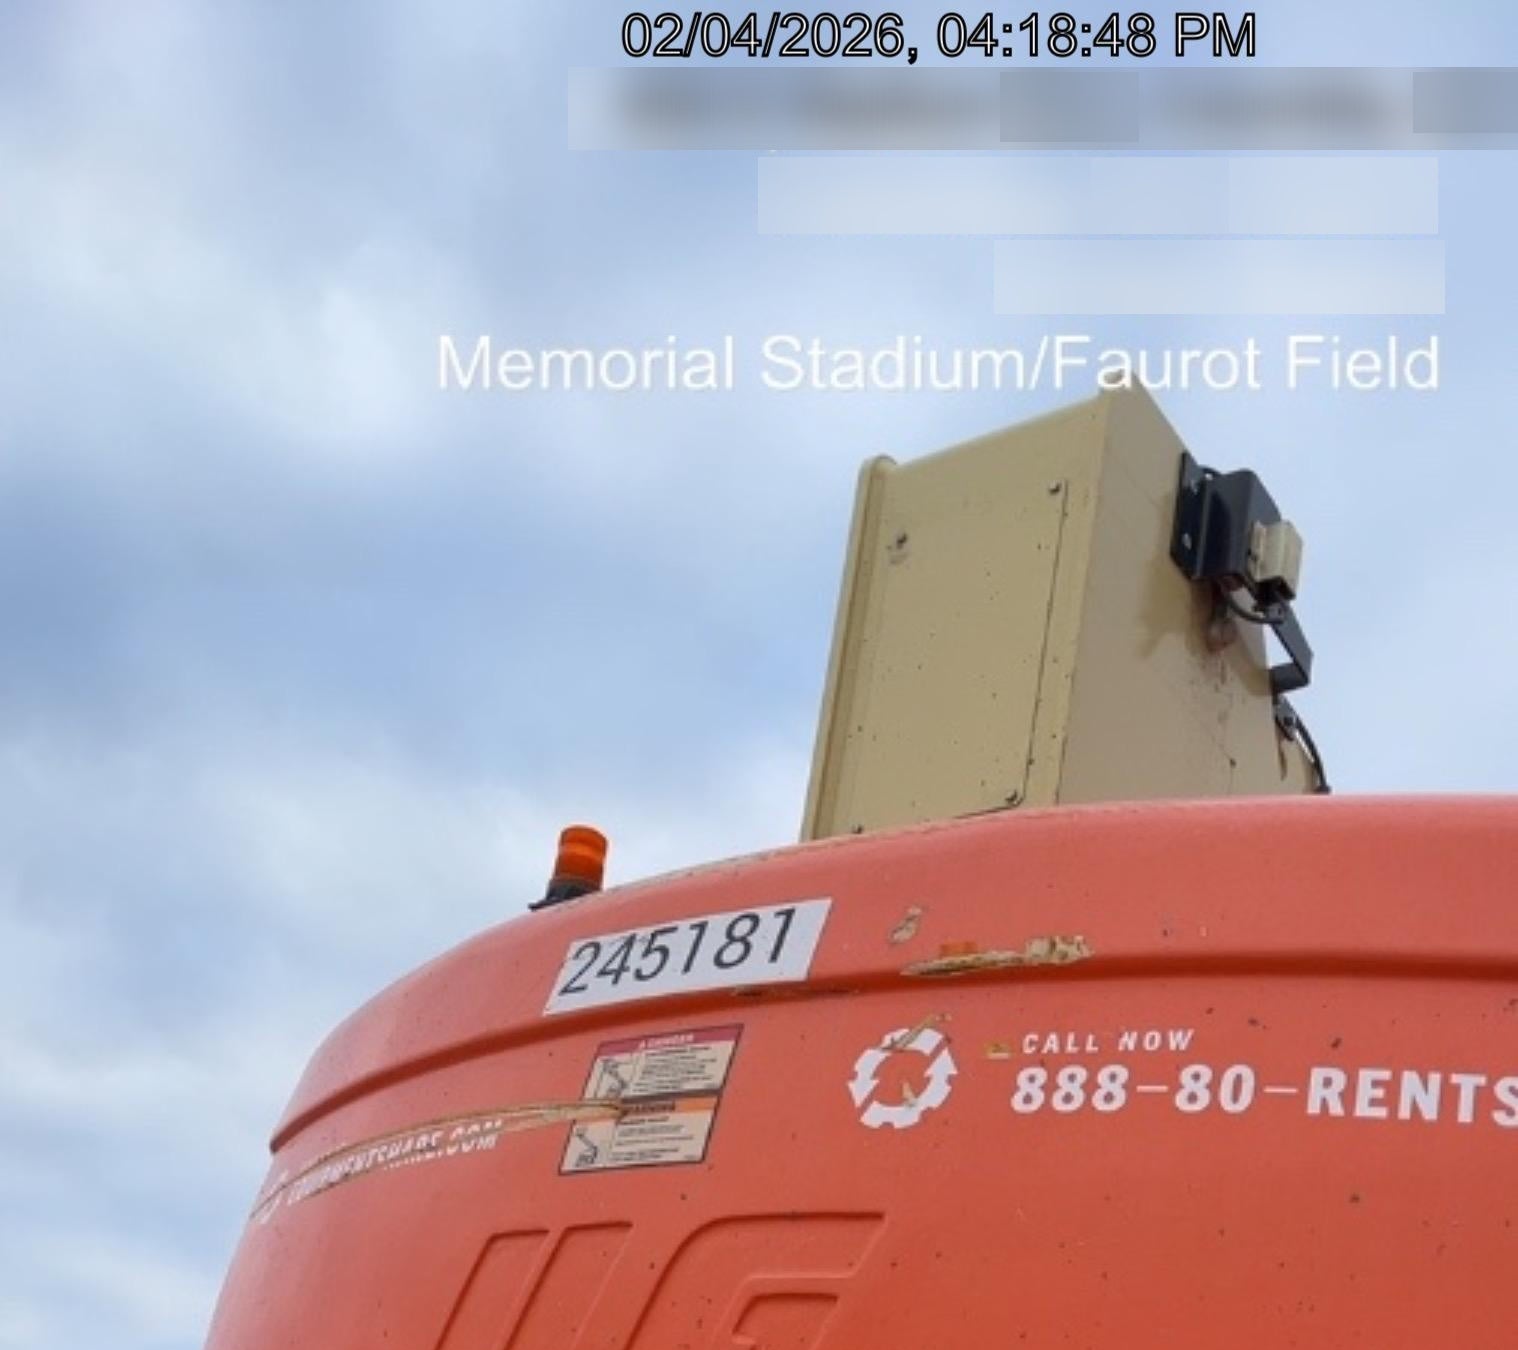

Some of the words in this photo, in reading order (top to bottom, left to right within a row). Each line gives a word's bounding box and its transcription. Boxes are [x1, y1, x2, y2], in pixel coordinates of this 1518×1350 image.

[558, 908, 796, 997] 245181
[1021, 1032, 1099, 1055] CALL
[1118, 1028, 1195, 1052] NOW
